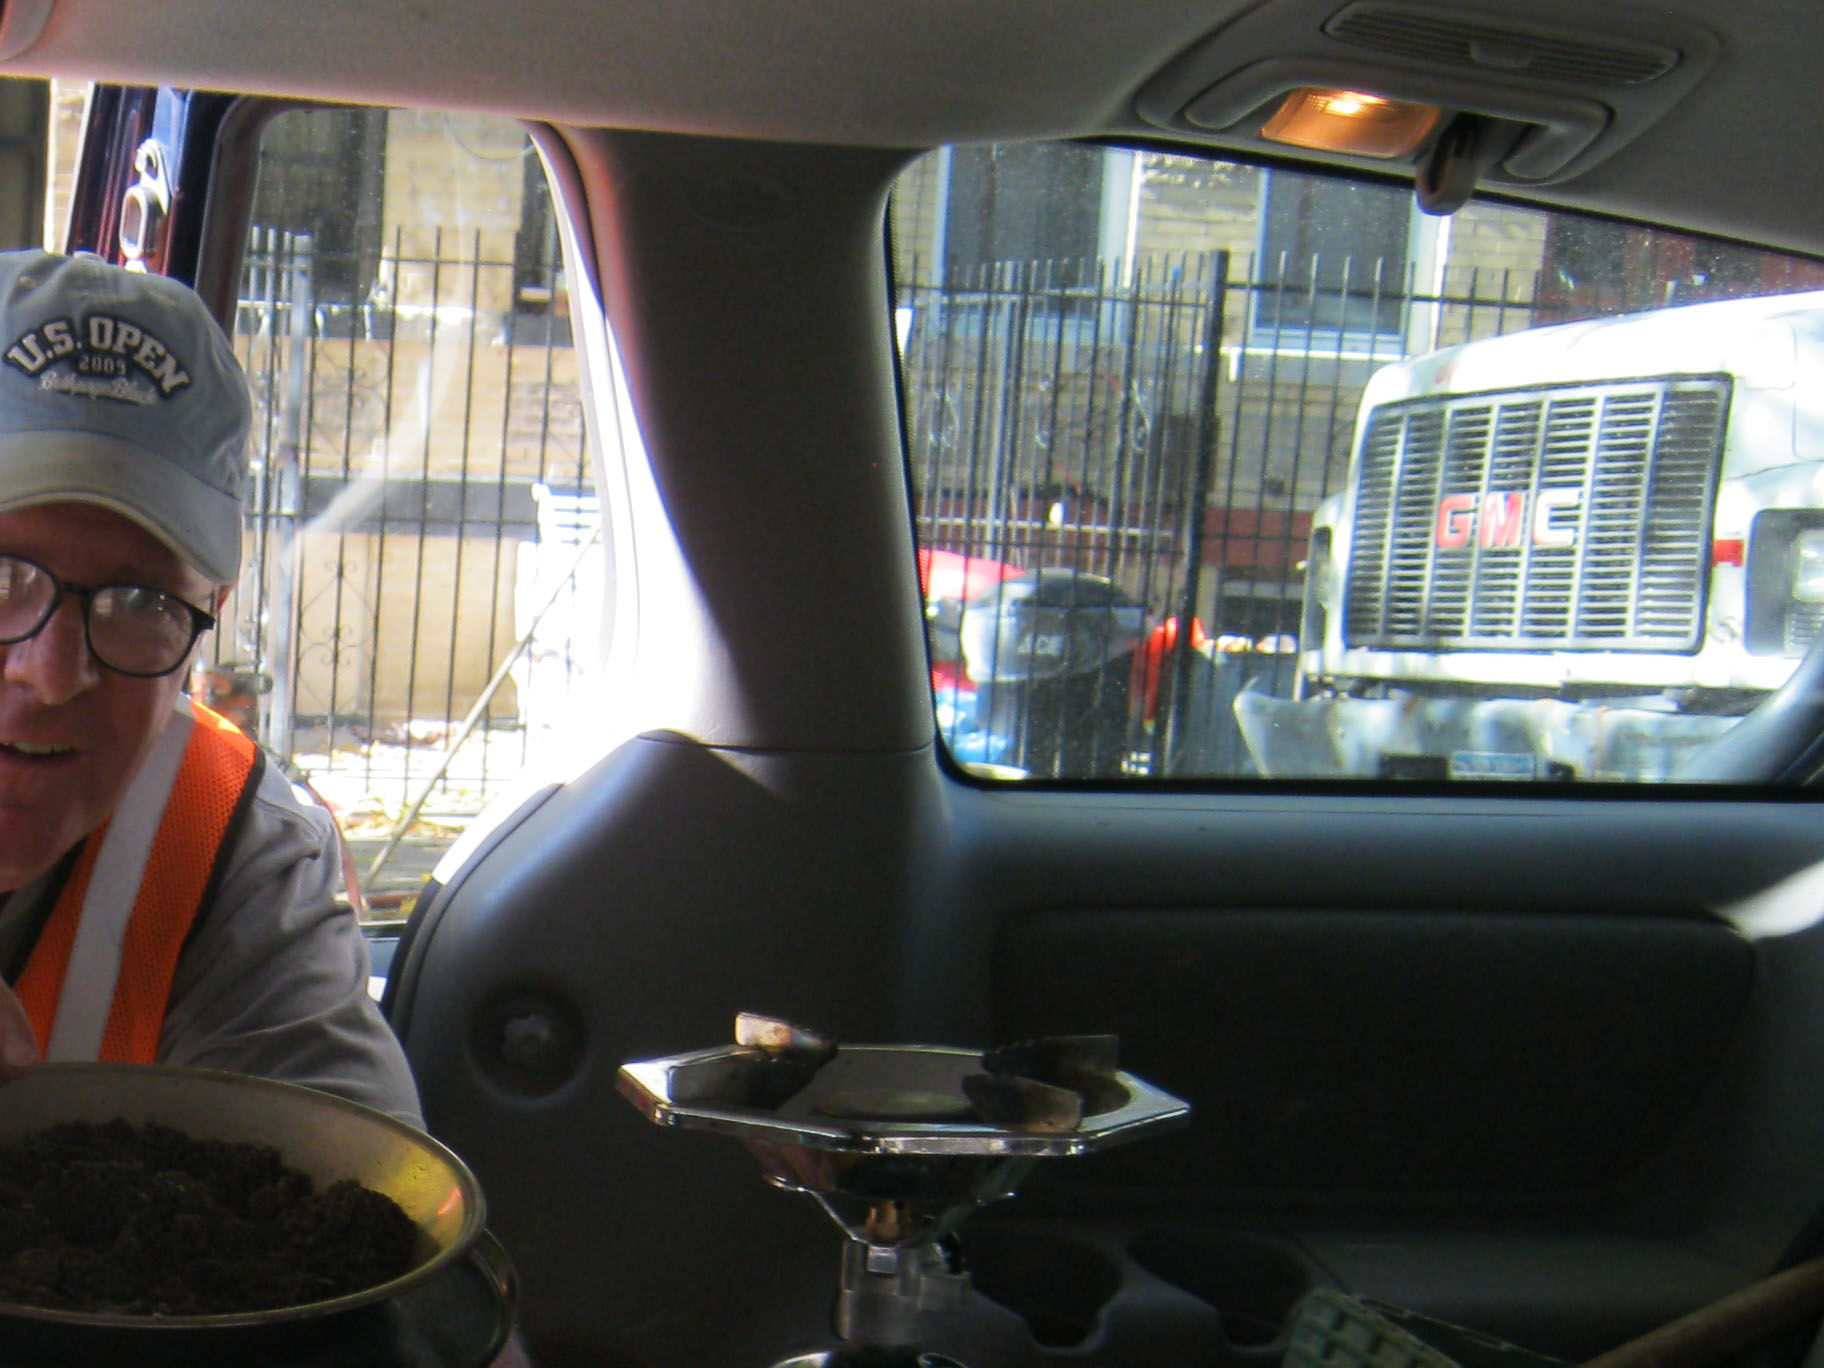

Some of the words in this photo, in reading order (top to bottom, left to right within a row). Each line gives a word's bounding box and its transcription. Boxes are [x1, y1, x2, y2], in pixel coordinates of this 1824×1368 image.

[5, 318, 84, 374] U.S.
[88, 315, 191, 396] OPEN
[77, 354, 128, 375] 2009
[1435, 486, 1584, 549] GMC
